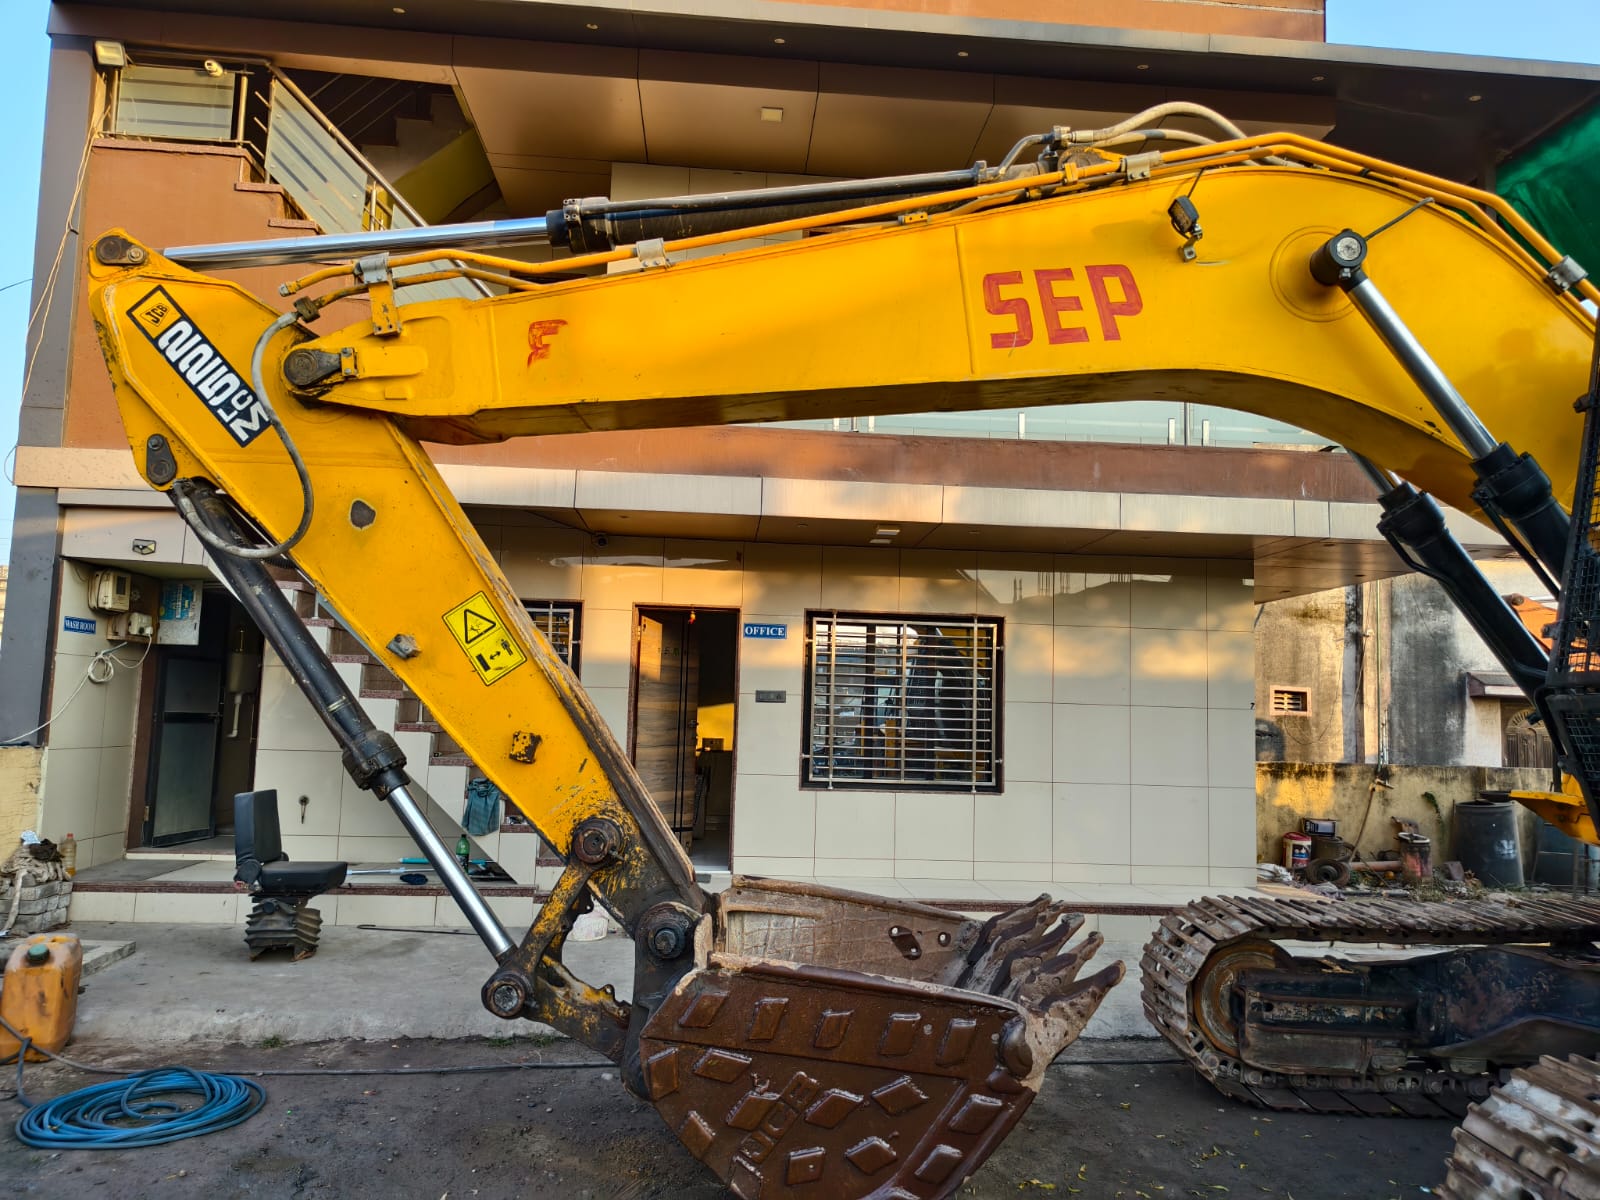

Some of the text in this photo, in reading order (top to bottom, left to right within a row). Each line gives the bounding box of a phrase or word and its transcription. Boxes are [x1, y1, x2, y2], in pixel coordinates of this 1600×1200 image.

[145, 304, 169, 324] JCB
[982, 263, 1144, 349] SEP
[744, 625, 785, 636] OFFICE
[738, 1070, 821, 1165] JCB
